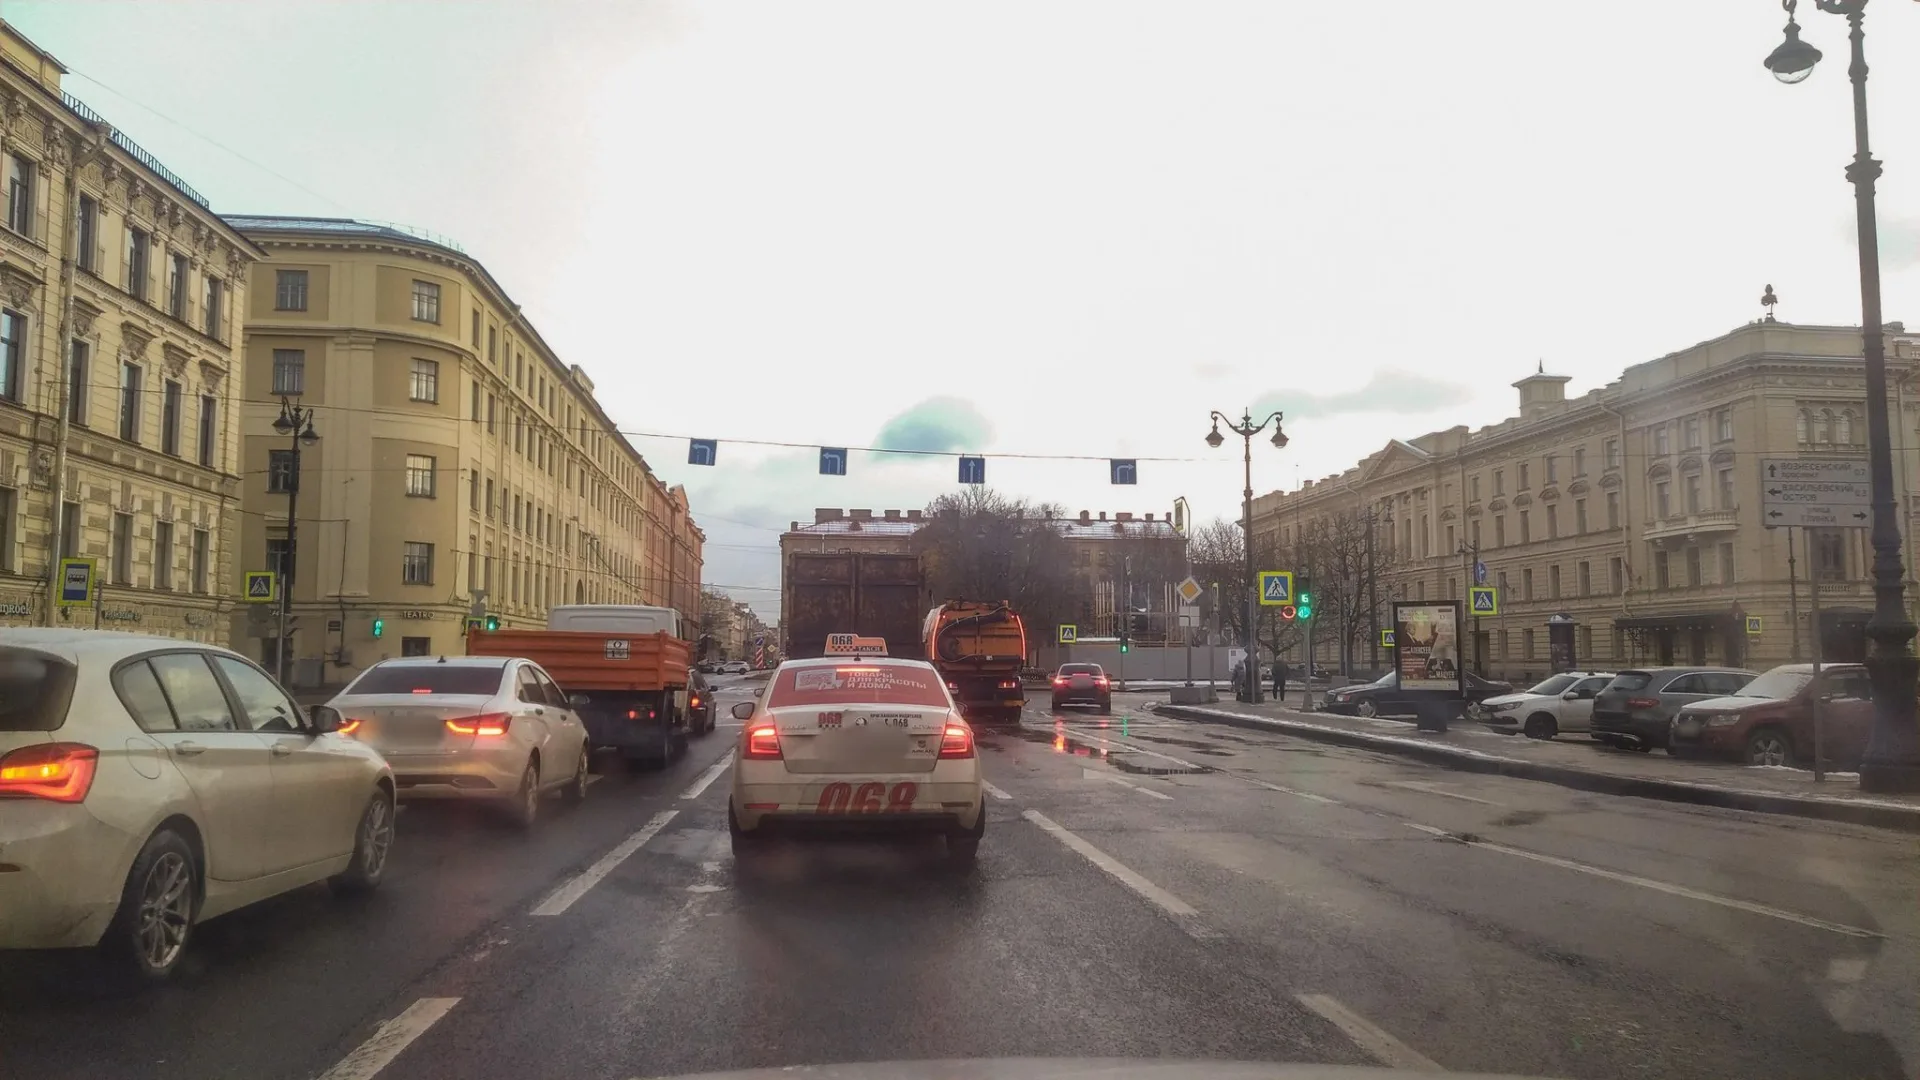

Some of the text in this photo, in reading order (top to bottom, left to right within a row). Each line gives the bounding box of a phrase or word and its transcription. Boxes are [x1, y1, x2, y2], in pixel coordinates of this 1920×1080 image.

[1780, 462, 1851, 471] ВОЗНЕСЕНСКИЙ
[1782, 483, 1854, 492] ВАСИЛЬЕВСКИЙ
[1782, 493, 1817, 501] ОСТРОВ
[403, 610, 435, 619] TEATRO
[831, 635, 853, 645] 068
[848, 671, 893, 679] ТОВАРЫ
[858, 682, 892, 690] ДОМА
[874, 677, 927, 689] КРАСОТЫ
[818, 712, 842, 724] 068
[893, 718, 909, 728] 068
[814, 781, 918, 815] 068
